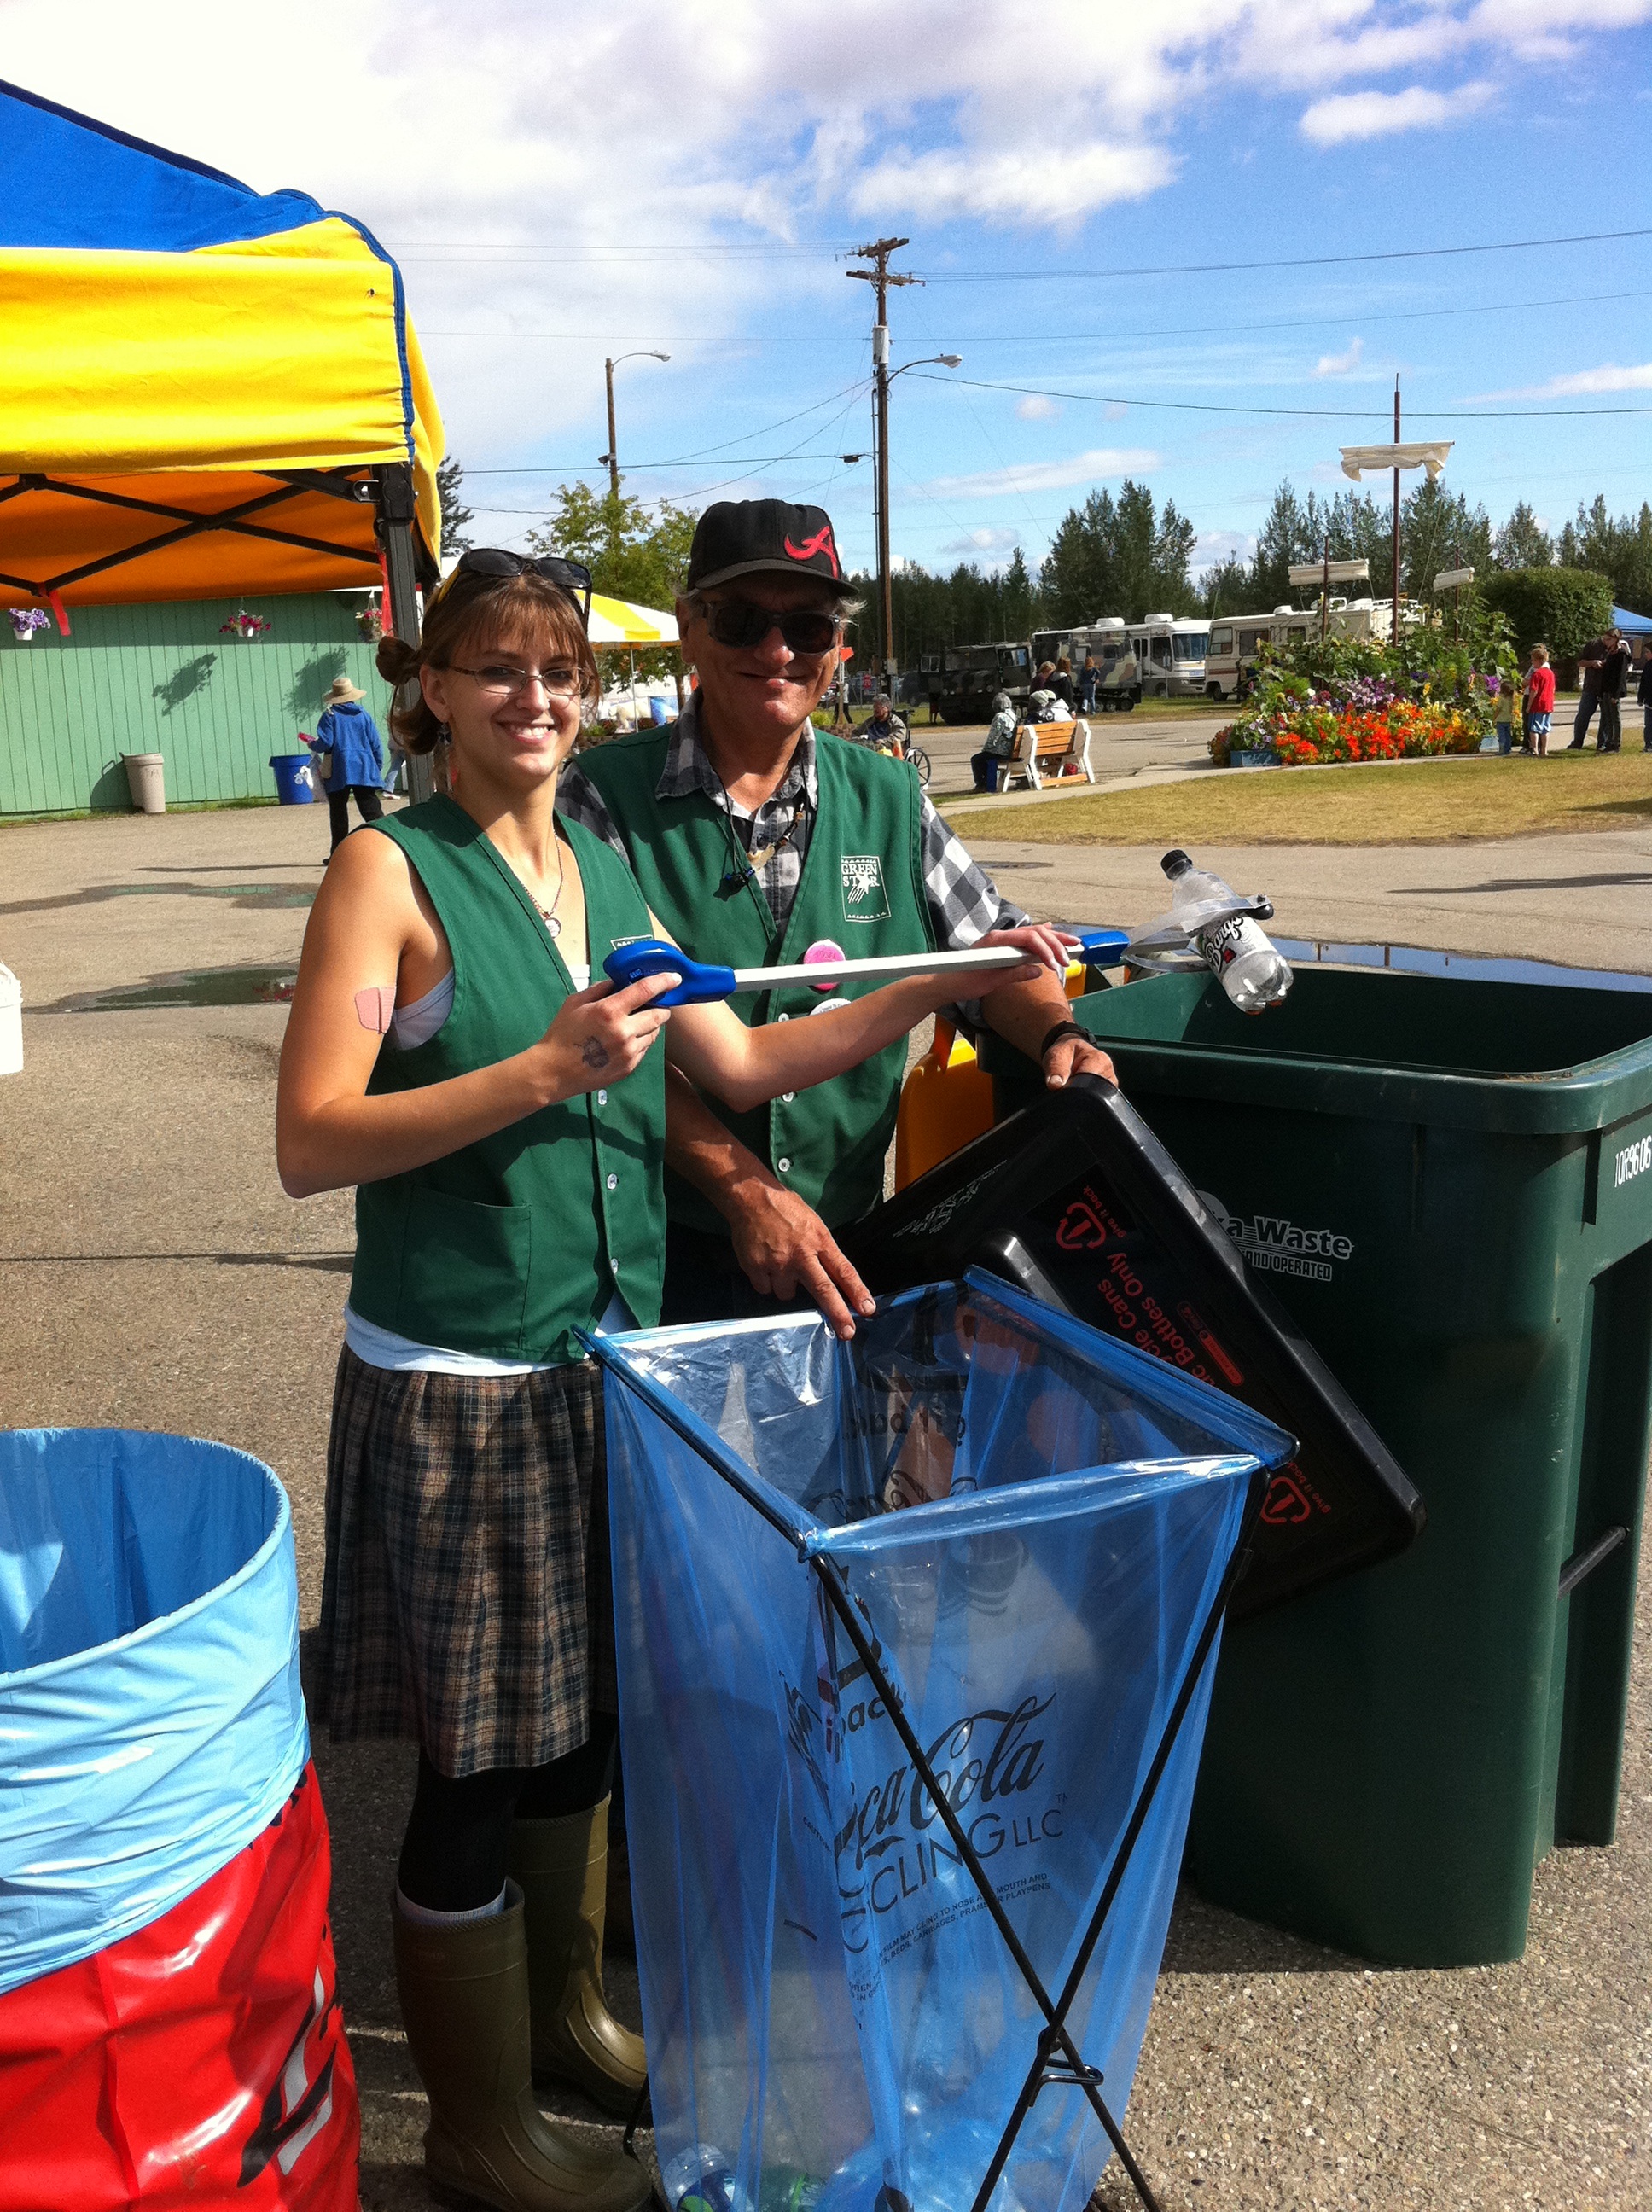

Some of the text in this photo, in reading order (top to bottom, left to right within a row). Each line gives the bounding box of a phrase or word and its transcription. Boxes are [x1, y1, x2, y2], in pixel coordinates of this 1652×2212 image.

[841, 864, 878, 876] GREEN
[1082, 1185, 1103, 1210] back
[1108, 1217, 1128, 1238] give
[1254, 1215, 1354, 1260] Waste
[1106, 1252, 1144, 1297] Only
[1270, 1254, 1333, 1282] OPERATED
[1096, 1278, 1137, 1330] Cans
[1141, 1295, 1195, 1366] Bottles
[1011, 1807, 1065, 1848] LLC
[941, 1907, 951, 1916] TO
[952, 1897, 974, 1912] NOSE
[997, 1878, 1027, 1894] MOUTH
[1028, 1873, 1048, 1884] AND
[1006, 1882, 1051, 1901] PLAYPENS
